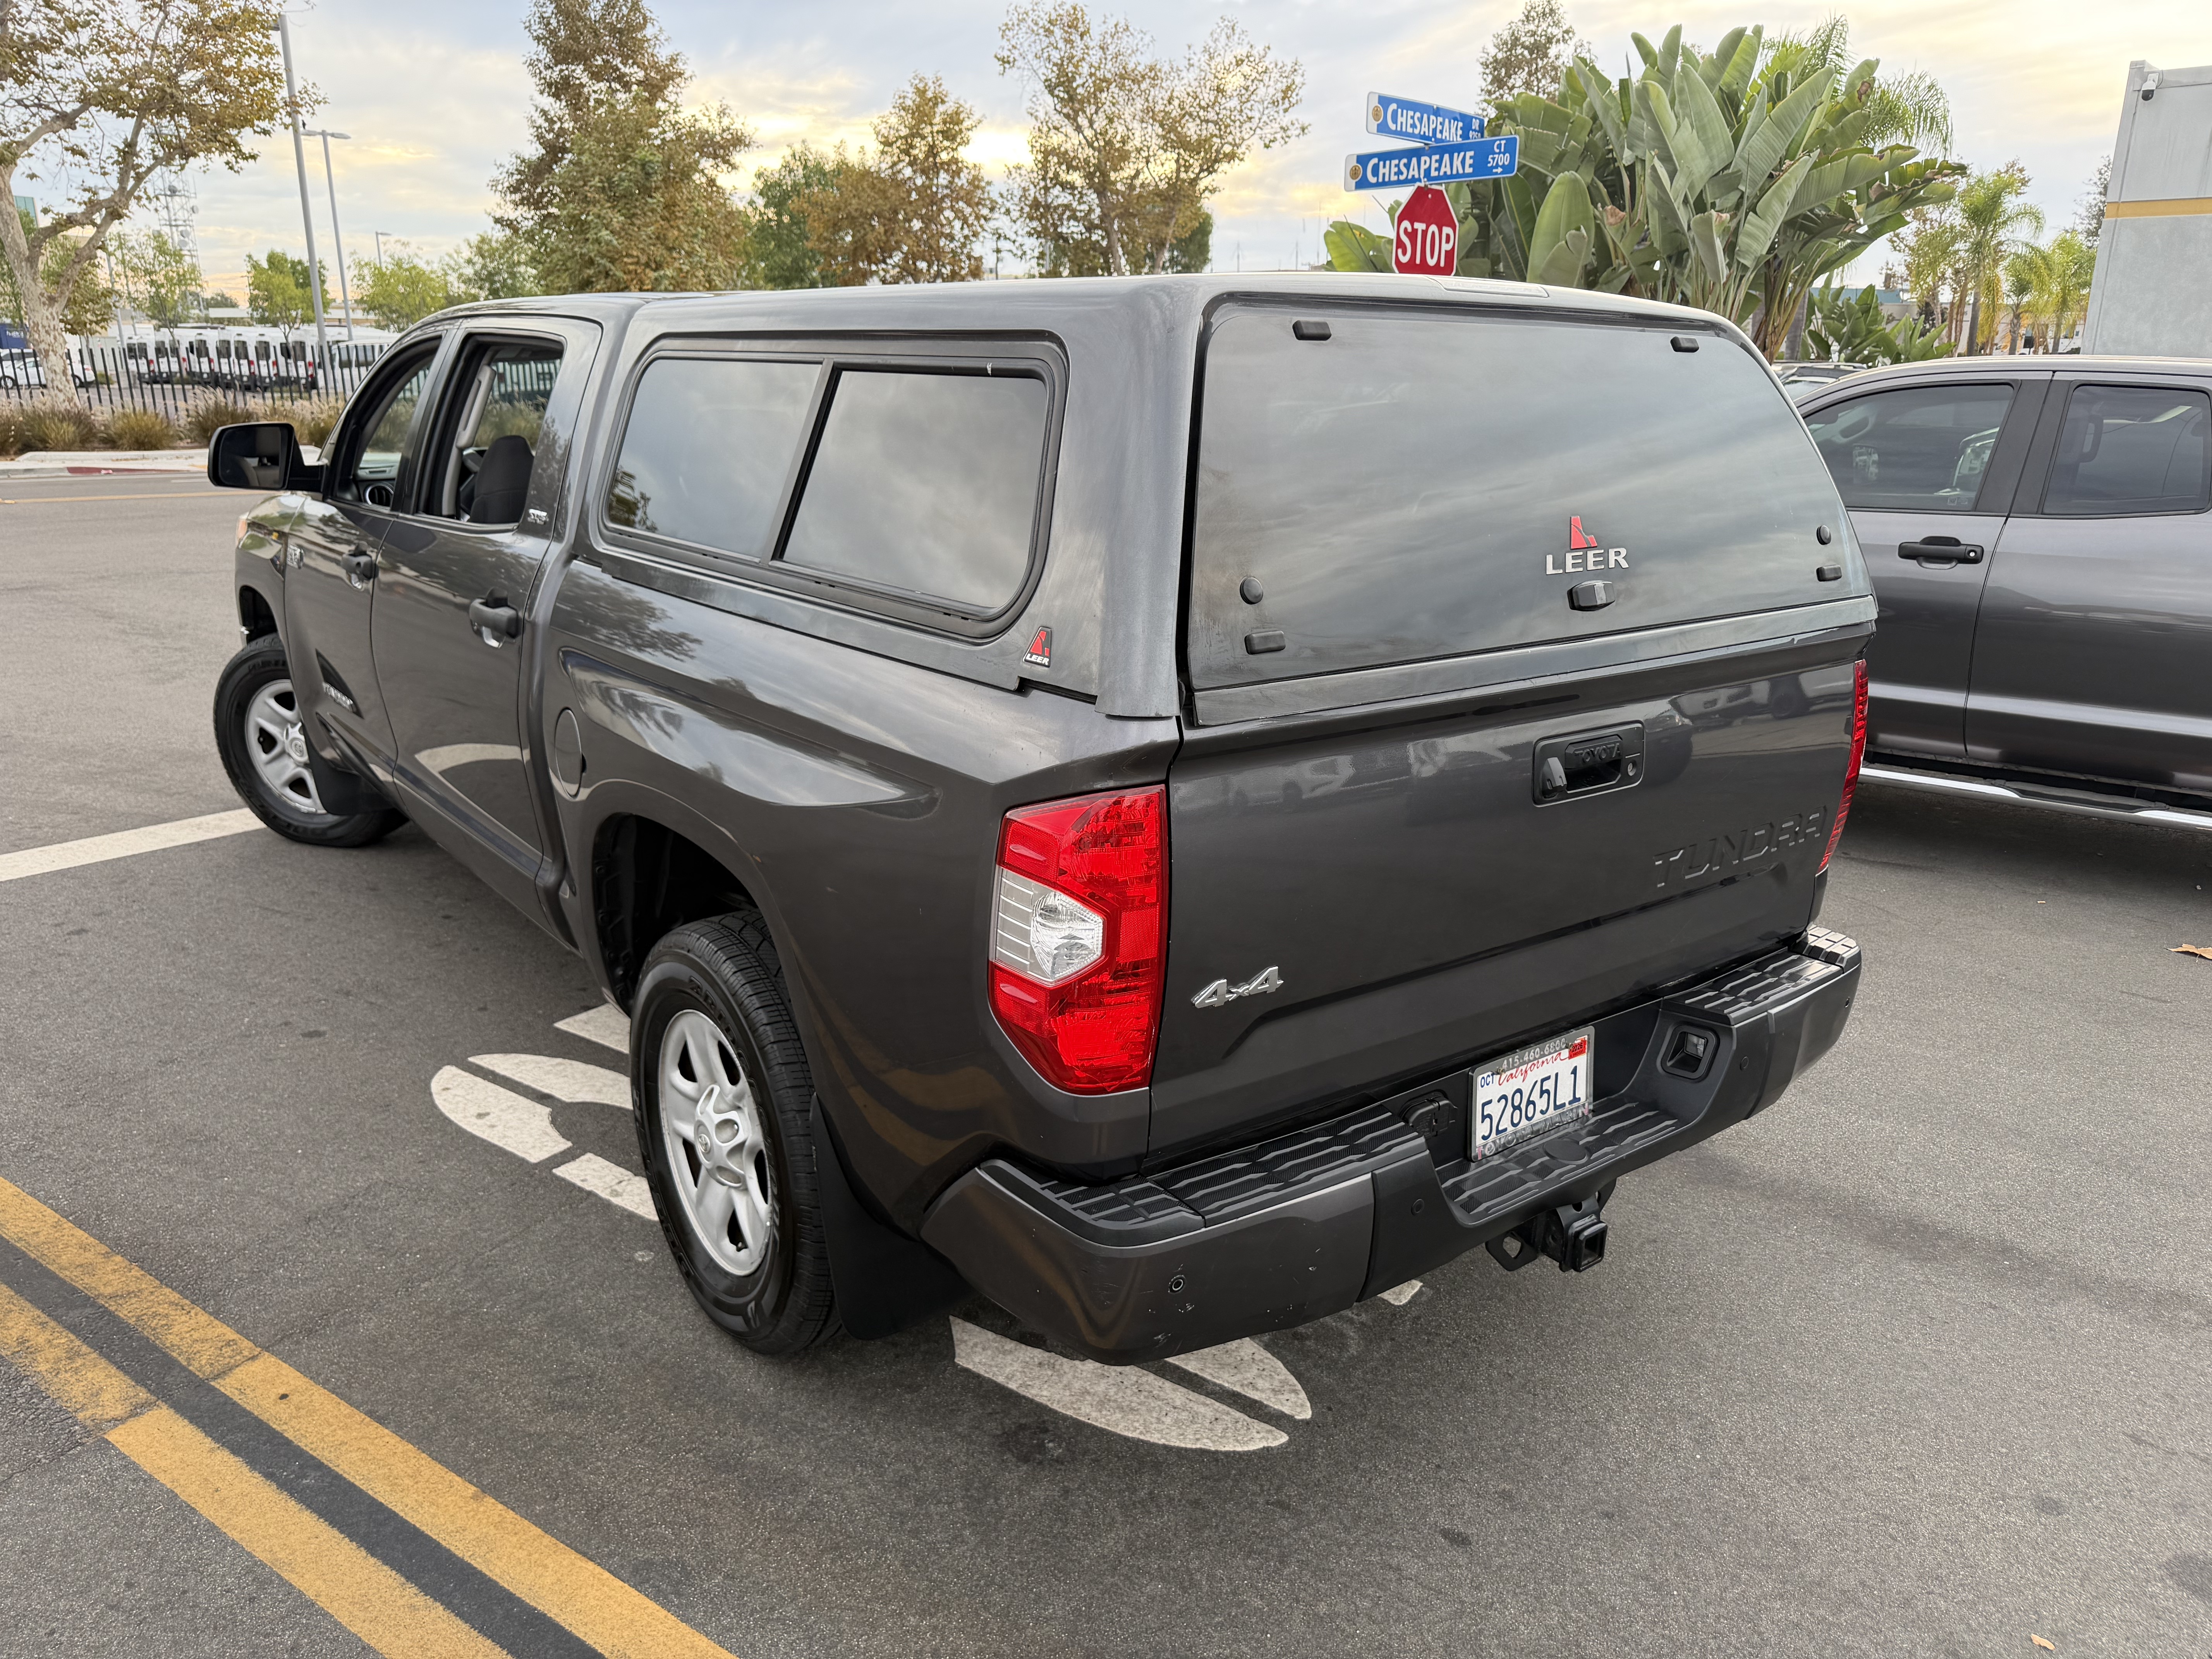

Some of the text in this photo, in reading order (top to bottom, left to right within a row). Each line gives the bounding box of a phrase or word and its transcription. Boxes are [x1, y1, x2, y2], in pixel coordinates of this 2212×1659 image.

[1387, 103, 1480, 142] CHESAPEAKE DR
[1487, 153, 1510, 167] 5700
[1494, 140, 1506, 153] CT
[1367, 151, 1474, 182] CHESAPEAKE
[1397, 220, 1454, 267] STOP
[1546, 547, 1629, 575] LEER
[1026, 653, 1049, 665] LEER
[1574, 742, 1620, 762] TOYOTA
[1653, 805, 1827, 888] TUNDRA
[1480, 1073, 1495, 1088] OCT
[1498, 1051, 1569, 1086] California
[1481, 1065, 1581, 1141] 52865L1
